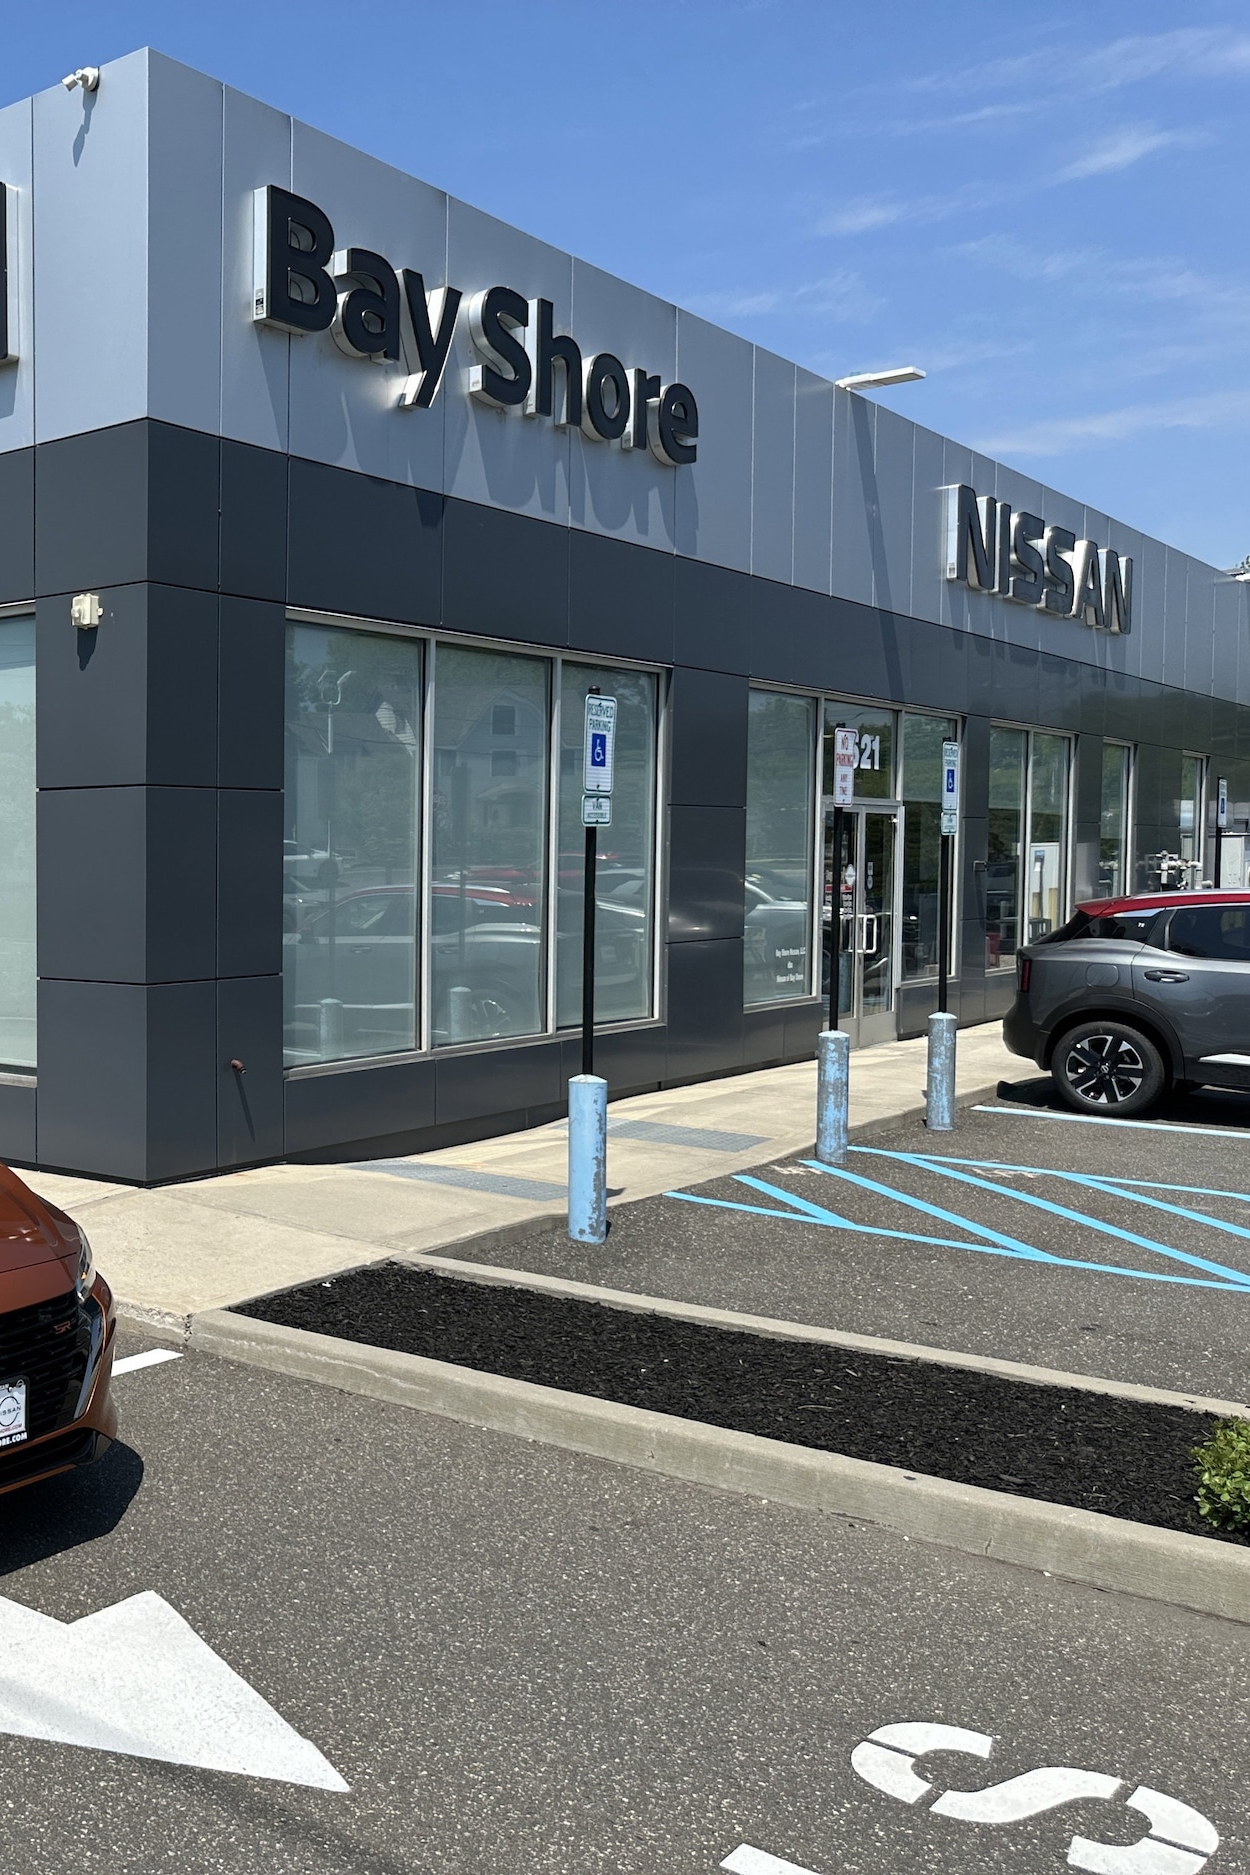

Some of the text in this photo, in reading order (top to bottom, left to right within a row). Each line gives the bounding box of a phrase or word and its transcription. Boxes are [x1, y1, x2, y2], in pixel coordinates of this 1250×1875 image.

[254, 184, 698, 466] Bay Shore
[948, 484, 1133, 634] NISSAN
[589, 718, 611, 732] PARKING
